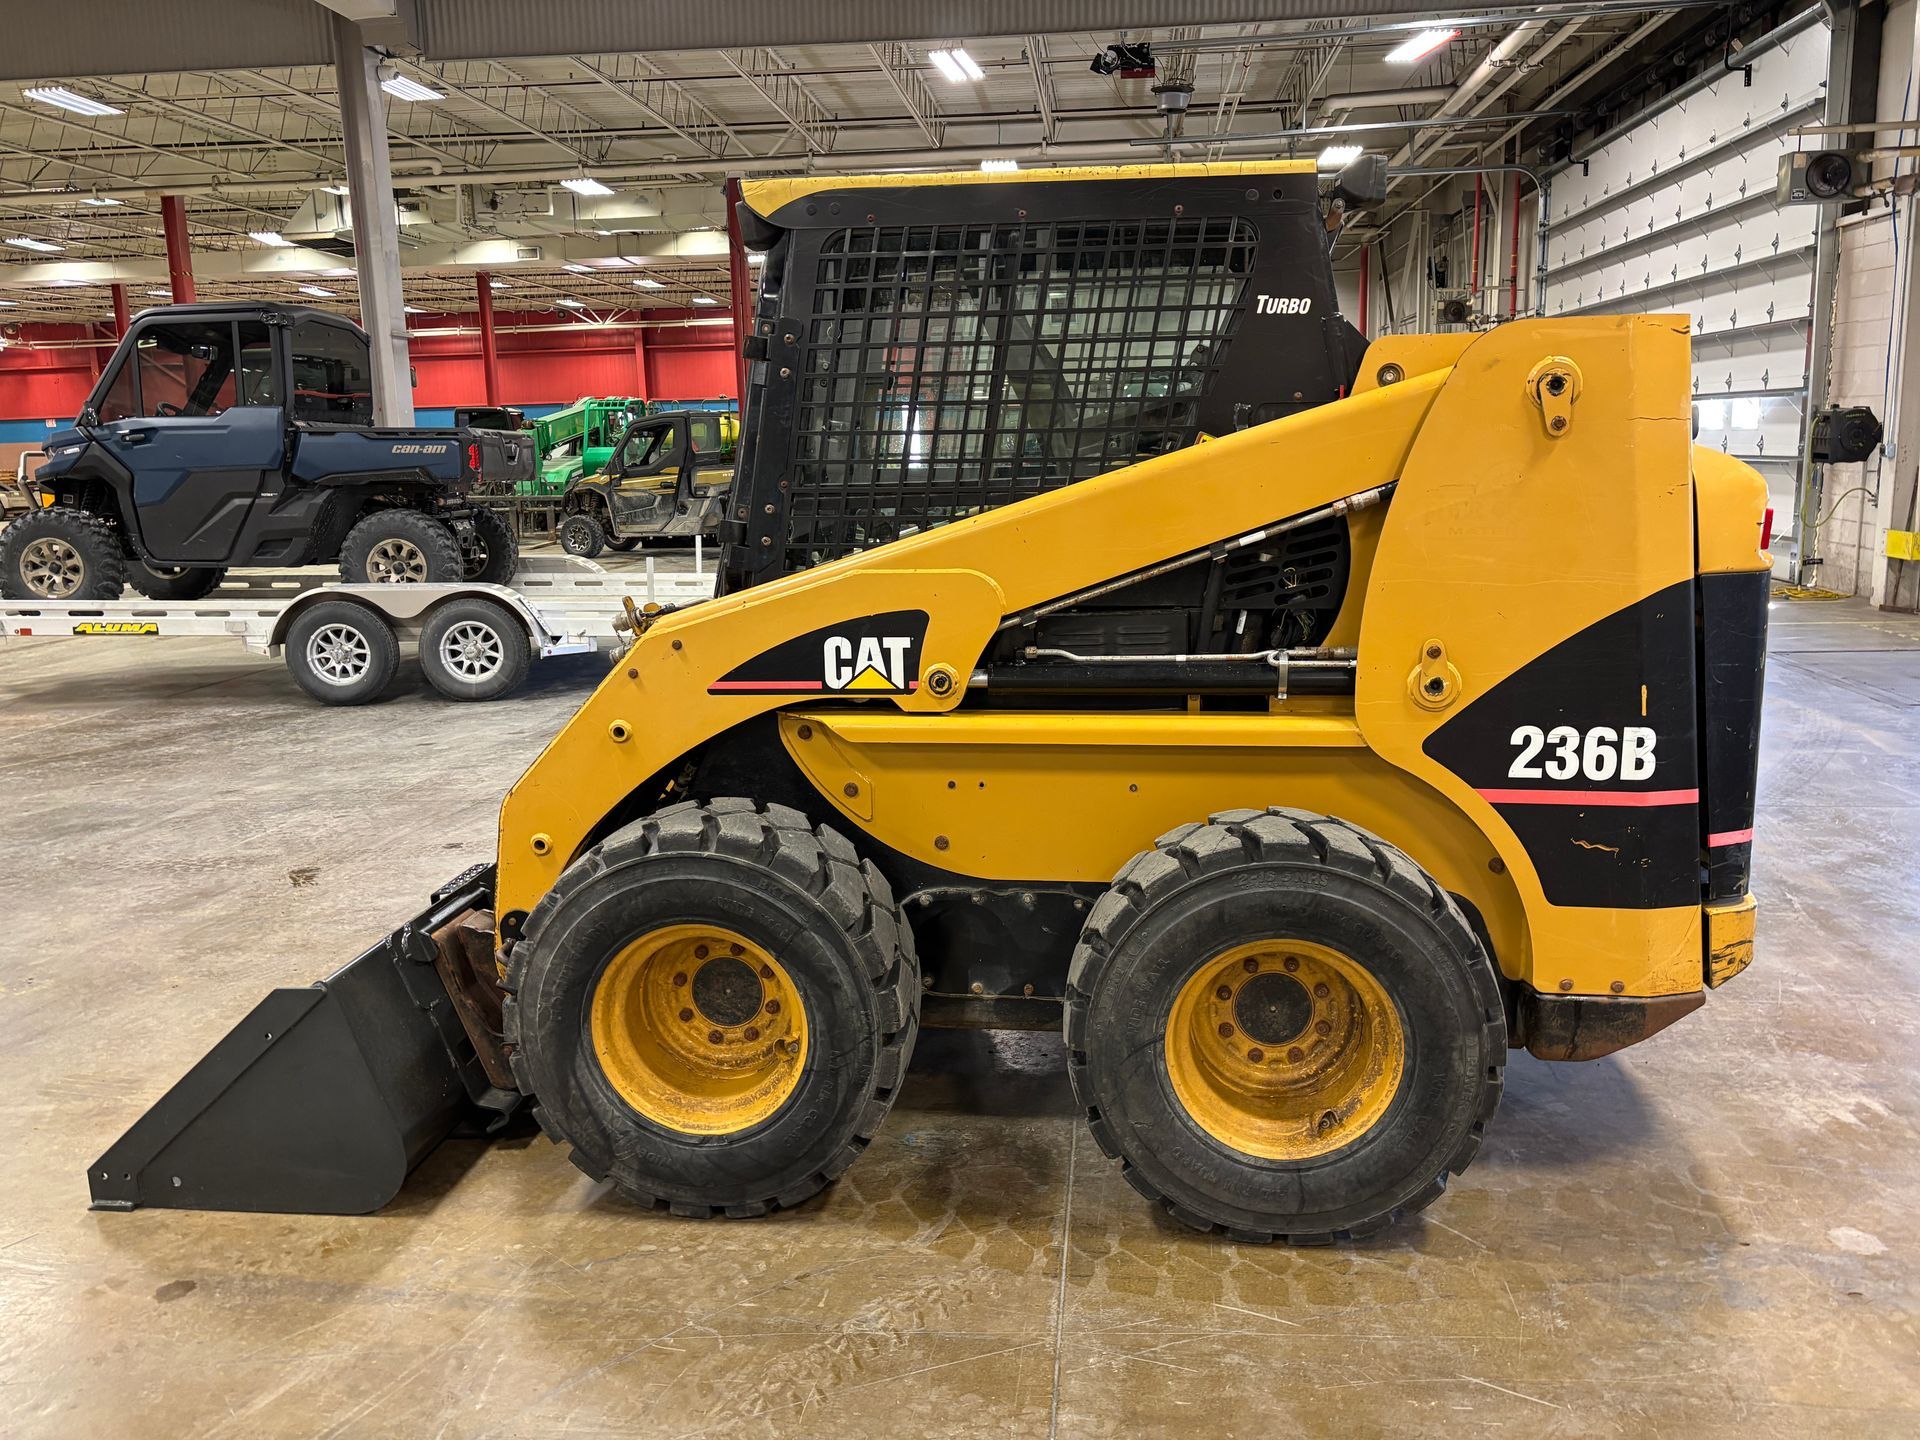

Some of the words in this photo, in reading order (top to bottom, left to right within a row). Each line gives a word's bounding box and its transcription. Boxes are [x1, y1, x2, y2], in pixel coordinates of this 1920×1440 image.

[391, 444, 447, 454] can-am
[75, 622, 157, 633] ALUMA
[823, 636, 911, 689] CAT
[1507, 725, 1657, 781] 236B
